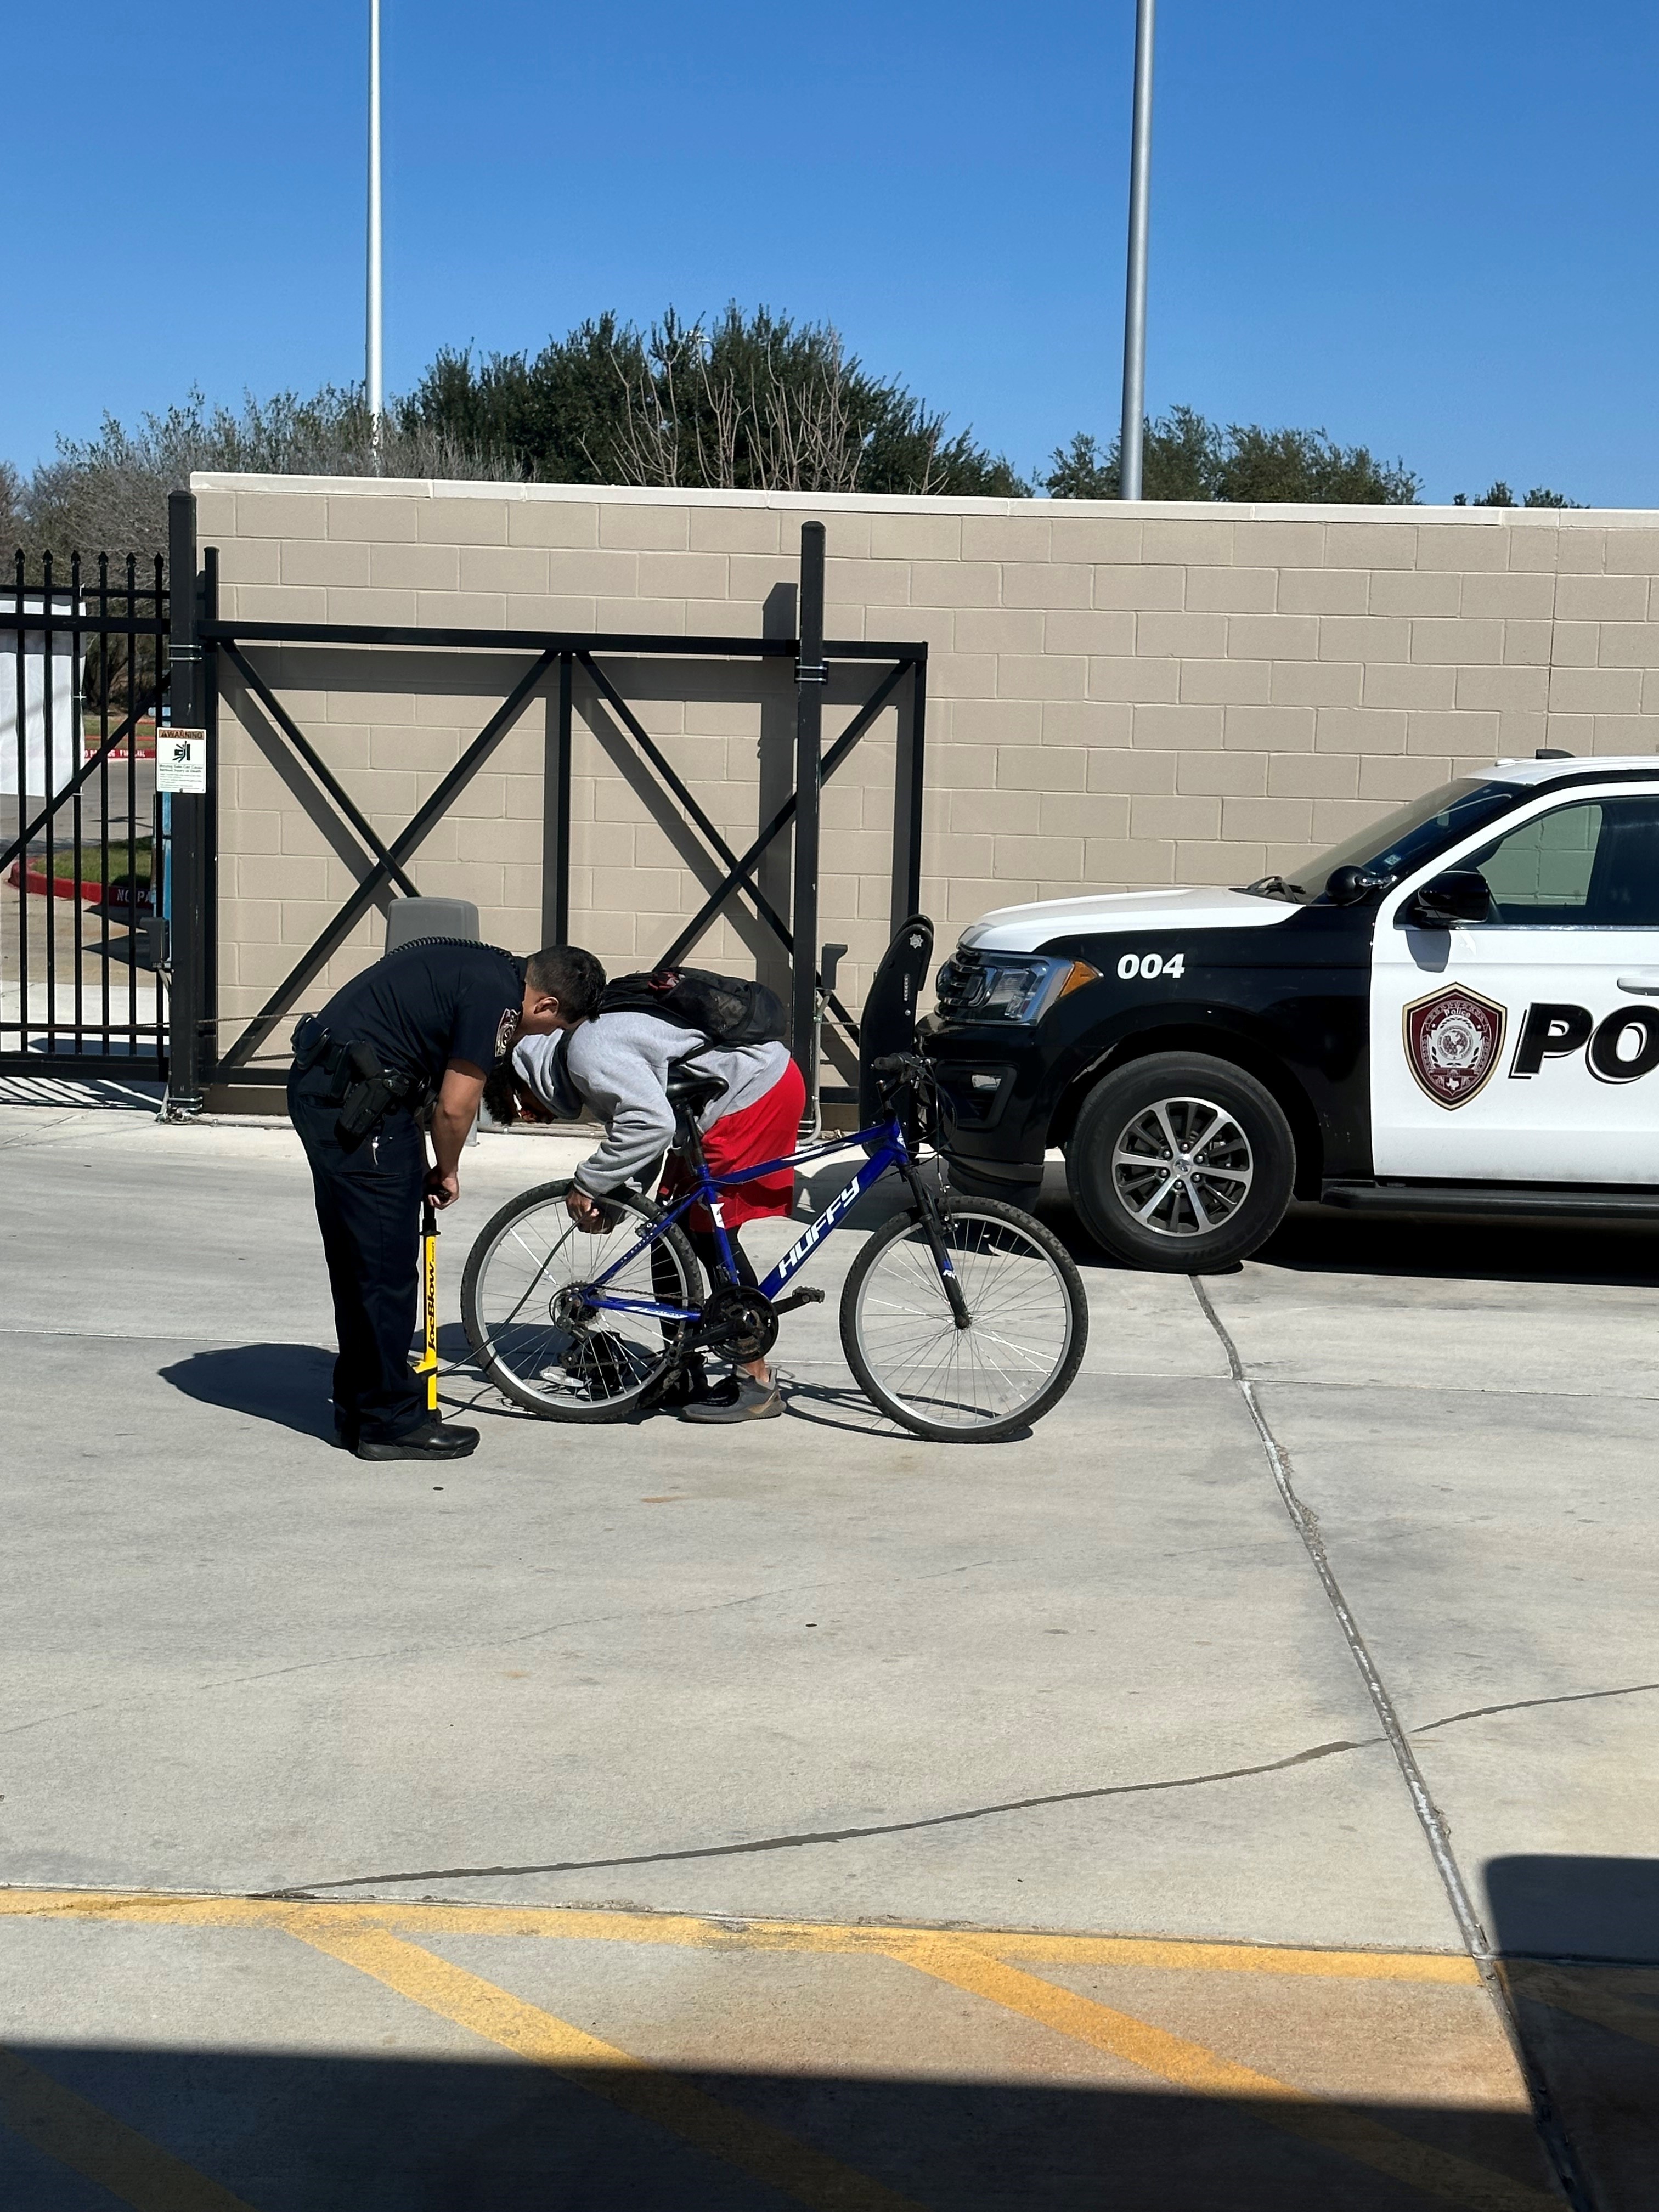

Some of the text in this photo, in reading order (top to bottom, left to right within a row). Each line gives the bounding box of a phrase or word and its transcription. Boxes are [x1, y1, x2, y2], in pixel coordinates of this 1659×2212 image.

[168, 730, 203, 740] WARNING
[1117, 953, 1185, 979] 004
[1443, 1007, 1471, 1018] Police
[778, 1176, 860, 1278] HUFFY
[428, 1262, 436, 1352] JoeBlow
